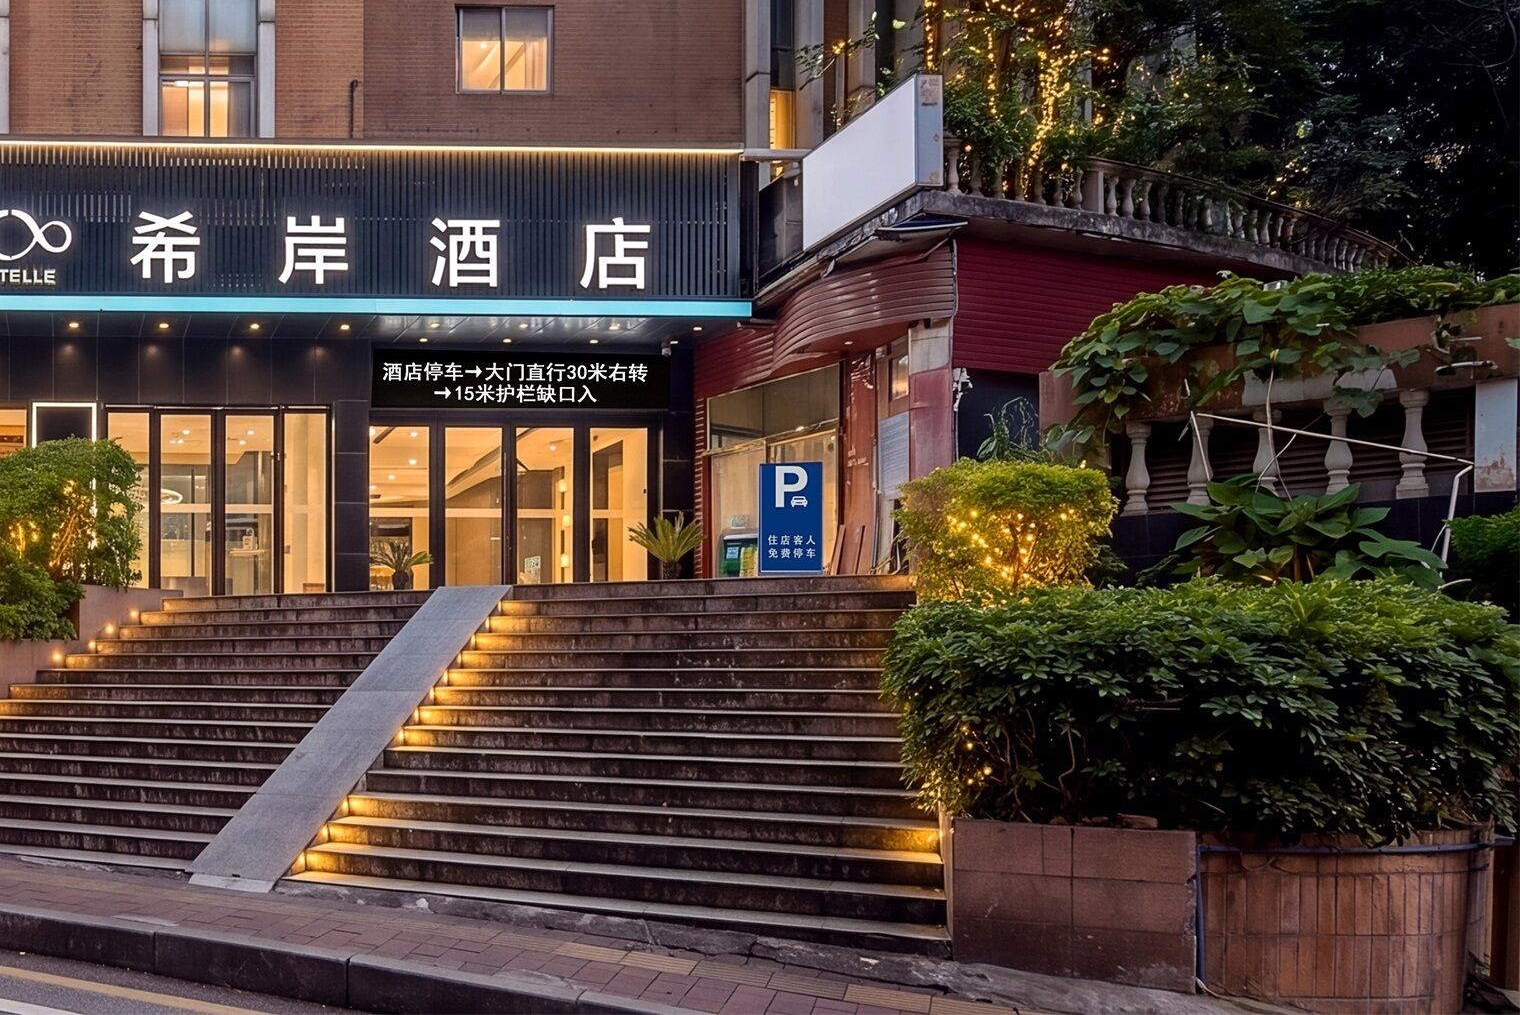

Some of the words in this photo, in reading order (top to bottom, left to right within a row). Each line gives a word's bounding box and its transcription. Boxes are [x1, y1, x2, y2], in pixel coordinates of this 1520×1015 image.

[130, 211, 650, 289] 希岸酒店
[775, 466, 808, 508] P
[767, 535, 816, 546] 住店客人
[768, 548, 816, 559] 免费停车
